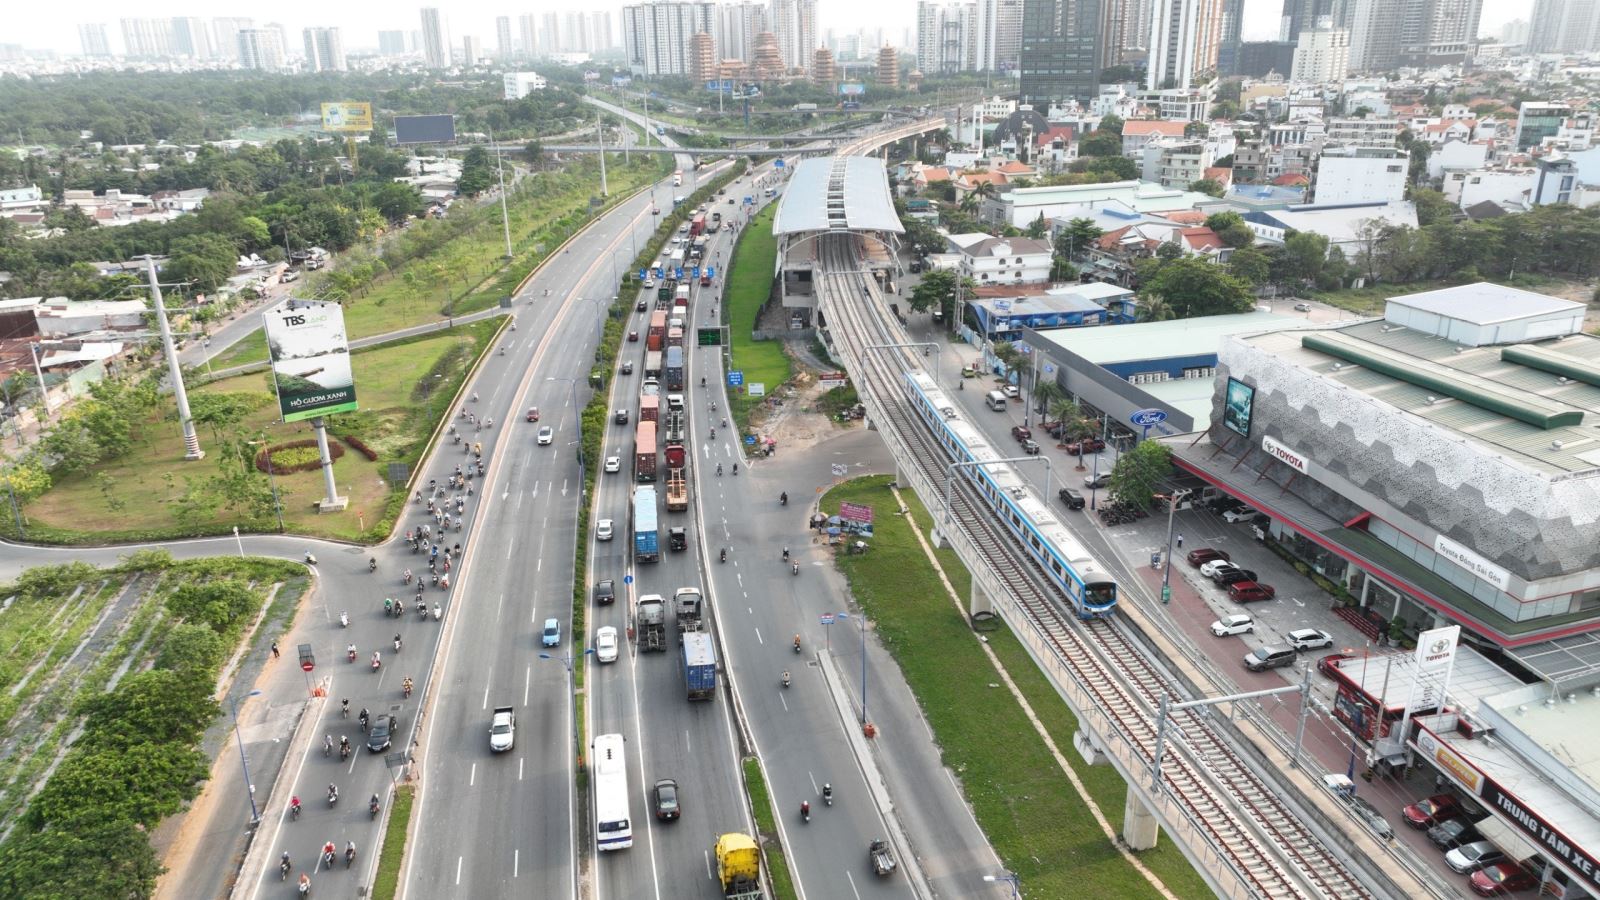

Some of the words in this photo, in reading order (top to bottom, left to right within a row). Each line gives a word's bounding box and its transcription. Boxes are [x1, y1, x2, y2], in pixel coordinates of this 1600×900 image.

[282, 314, 306, 327] TBS
[326, 391, 347, 400] XANH
[1139, 412, 1161, 424] Ford
[1275, 446, 1304, 470] TOYOTA
[1439, 542, 1458, 559] Toyota
[1425, 651, 1450, 662] TOYOTA
[1496, 791, 1538, 833] TRUNG
[1541, 826, 1571, 859] TÂM
[1572, 852, 1593, 876] XE
